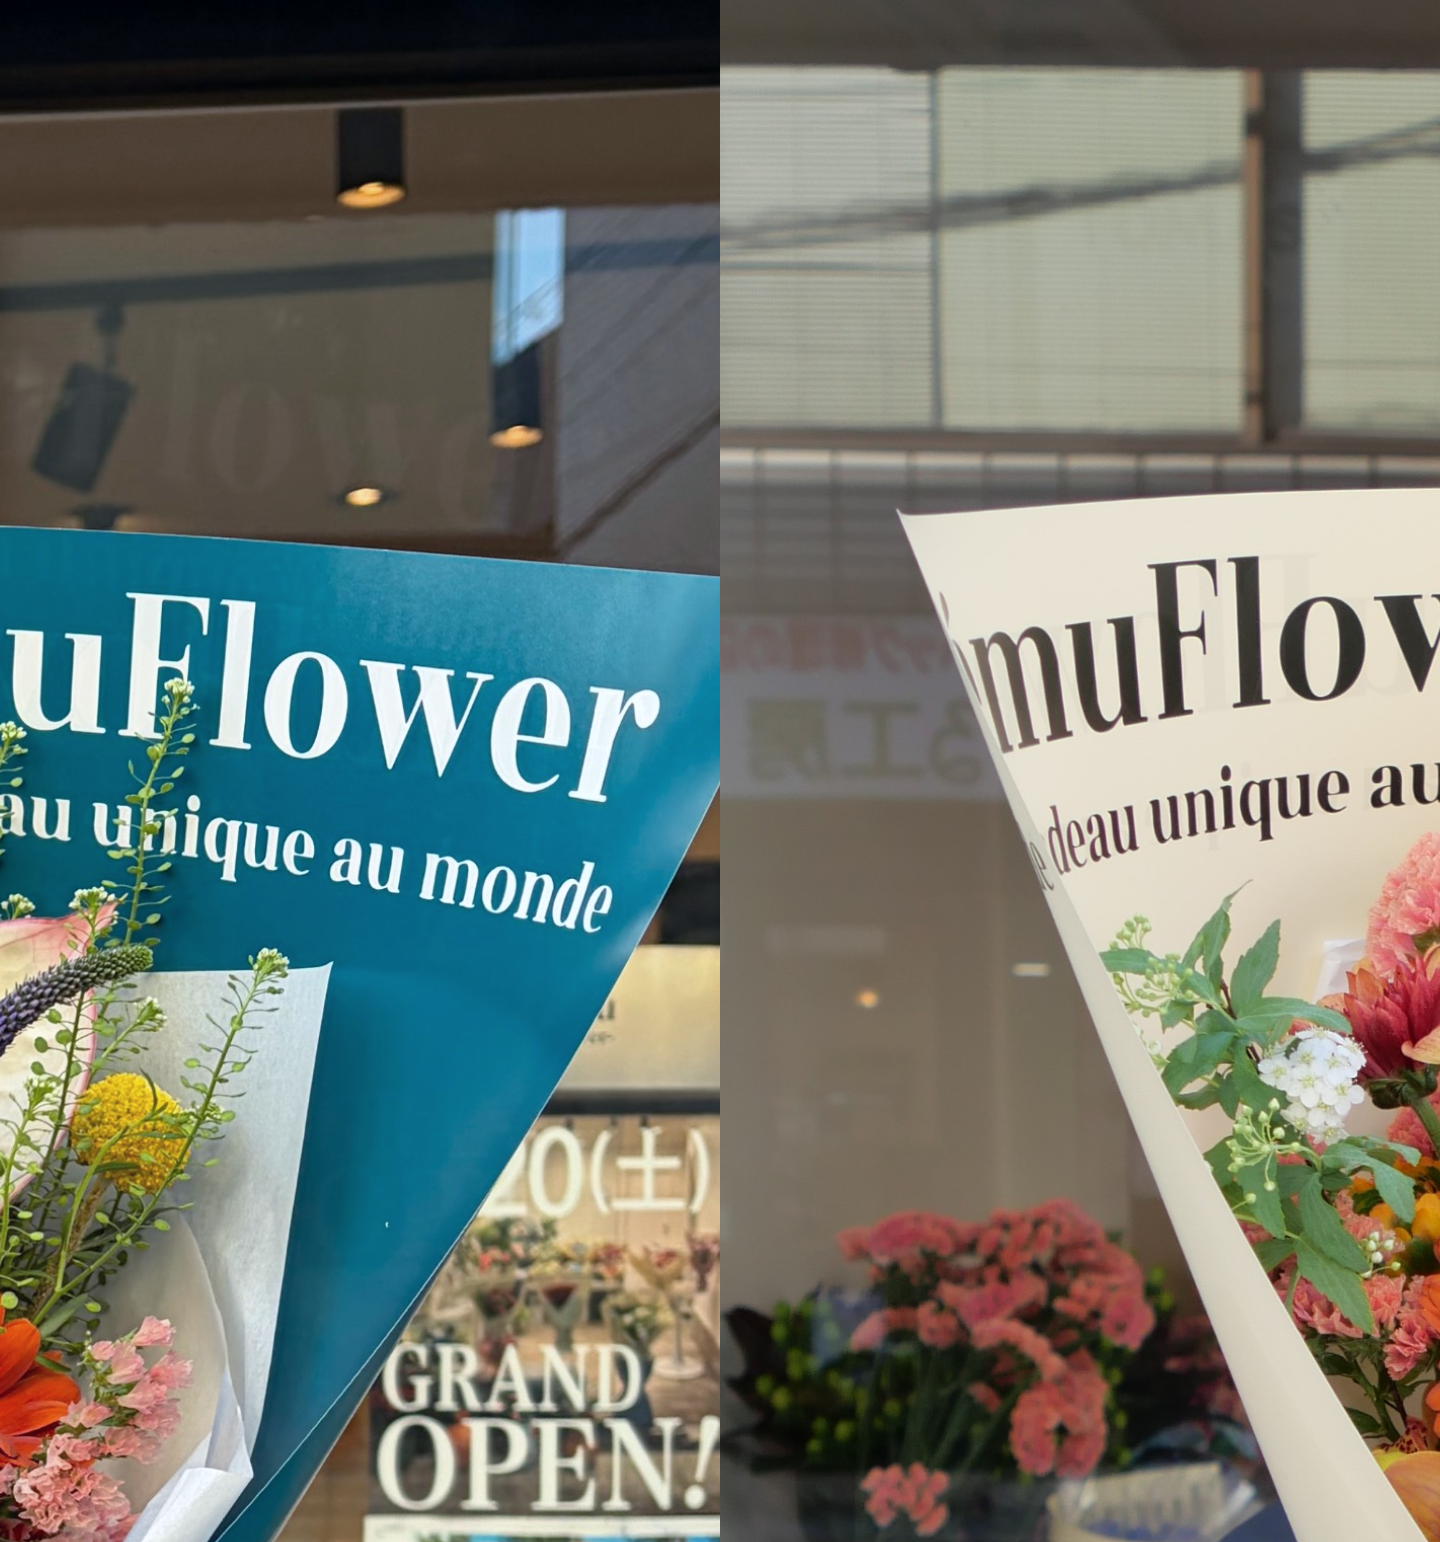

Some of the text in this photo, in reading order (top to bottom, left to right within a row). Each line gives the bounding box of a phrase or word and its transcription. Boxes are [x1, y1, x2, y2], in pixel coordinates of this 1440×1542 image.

[1150, 765, 1351, 845] unique
[93, 793, 315, 882] unique
[329, 836, 403, 894] au
[419, 853, 614, 934] monde
[382, 1341, 643, 1413] GRAND
[376, 1414, 720, 1511] OPEN!
